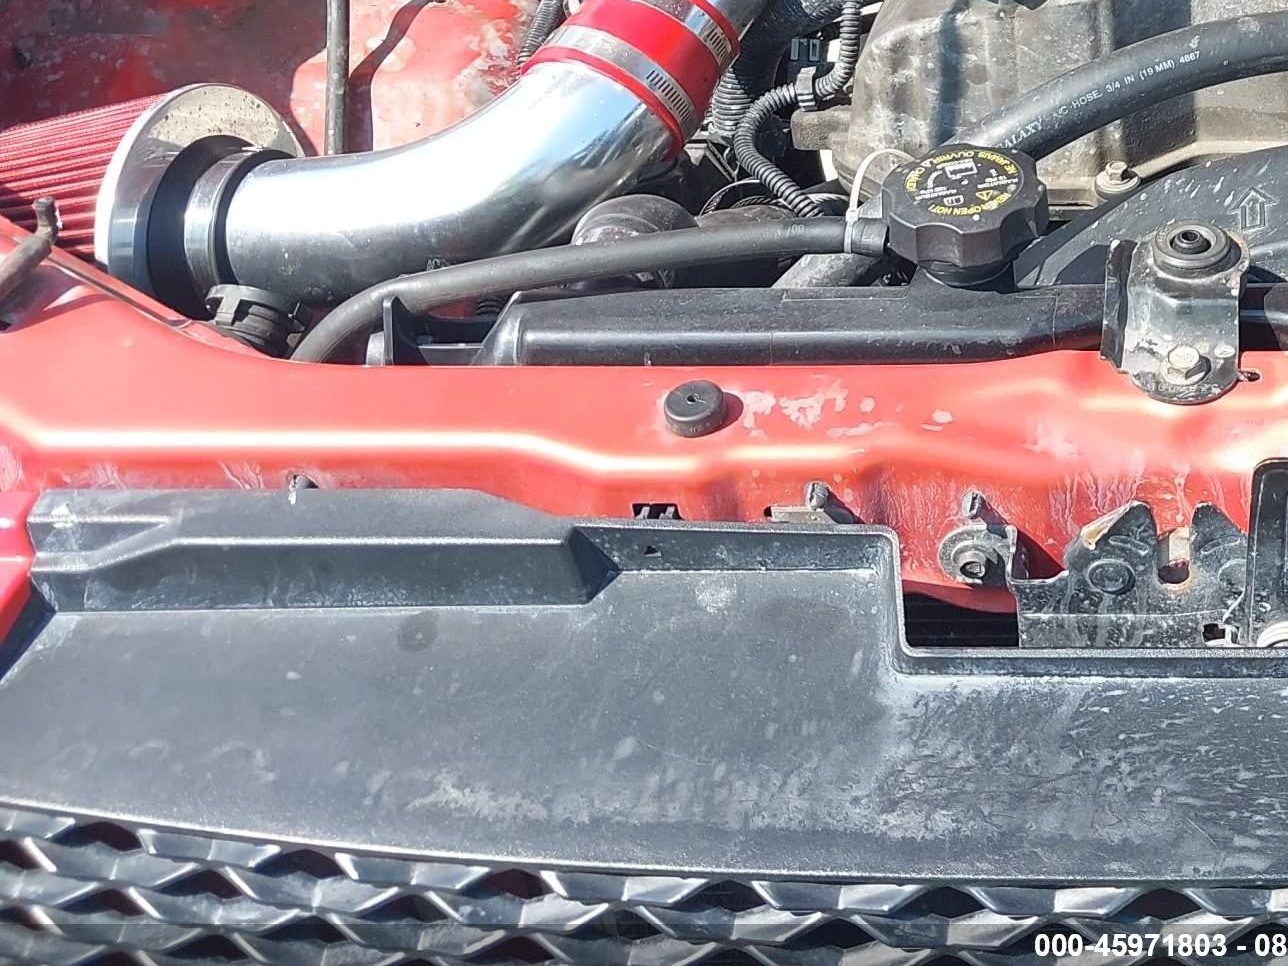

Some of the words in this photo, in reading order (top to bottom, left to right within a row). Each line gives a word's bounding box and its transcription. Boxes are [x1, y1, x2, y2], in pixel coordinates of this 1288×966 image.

[995, 116, 1042, 148] ALAXY
[1105, 81, 1121, 93] 3/4
[1124, 74, 1135, 85] IN
[1139, 67, 1154, 81] (19
[1155, 60, 1175, 74] MM)
[932, 151, 975, 164] OUVRIR
[927, 203, 952, 215] HOT!
[952, 205, 981, 216] OPEN
